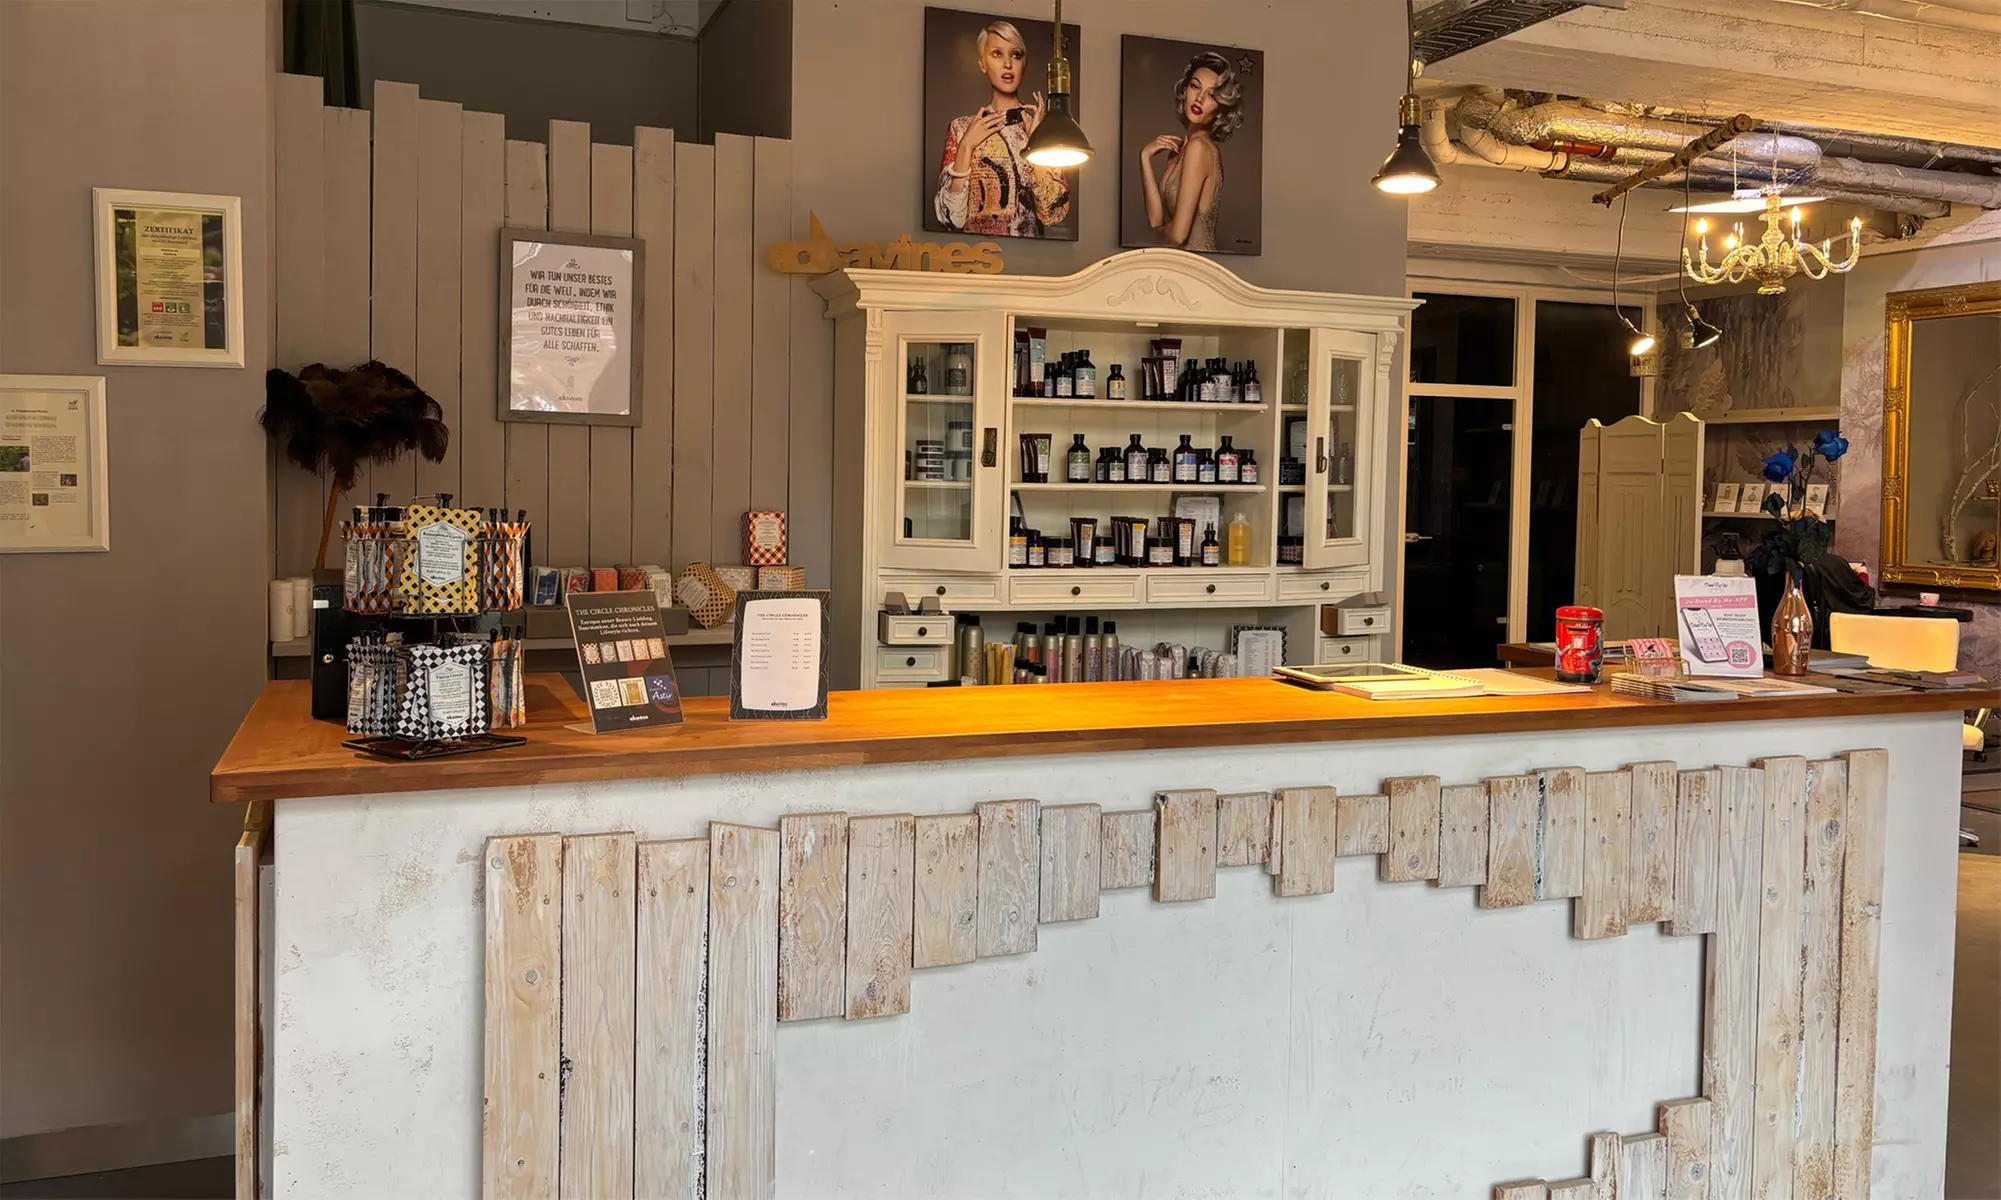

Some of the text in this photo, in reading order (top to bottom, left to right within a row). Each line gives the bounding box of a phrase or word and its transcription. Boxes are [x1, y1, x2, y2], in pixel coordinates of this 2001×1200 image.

[144, 226, 195, 234] ZERTIFIKAT
[768, 208, 1003, 274] davines
[530, 270, 612, 286] WIR TUN UNSER BESTES
[525, 282, 538, 294] FÜR
[540, 284, 551, 294] DIE
[579, 288, 600, 298] INDEM
[602, 289, 616, 299] WIR
[526, 297, 550, 308] DURCH
[596, 302, 614, 312] ETHIK
[528, 312, 614, 326] UND NACHHALTIGKEIT EIN
[540, 326, 563, 336] GUTES
[564, 328, 586, 338] LEBEN
[543, 340, 559, 350] ALLE
[590, 608, 613, 616] CIRCLE
[614, 606, 655, 614] CHRONICLES
